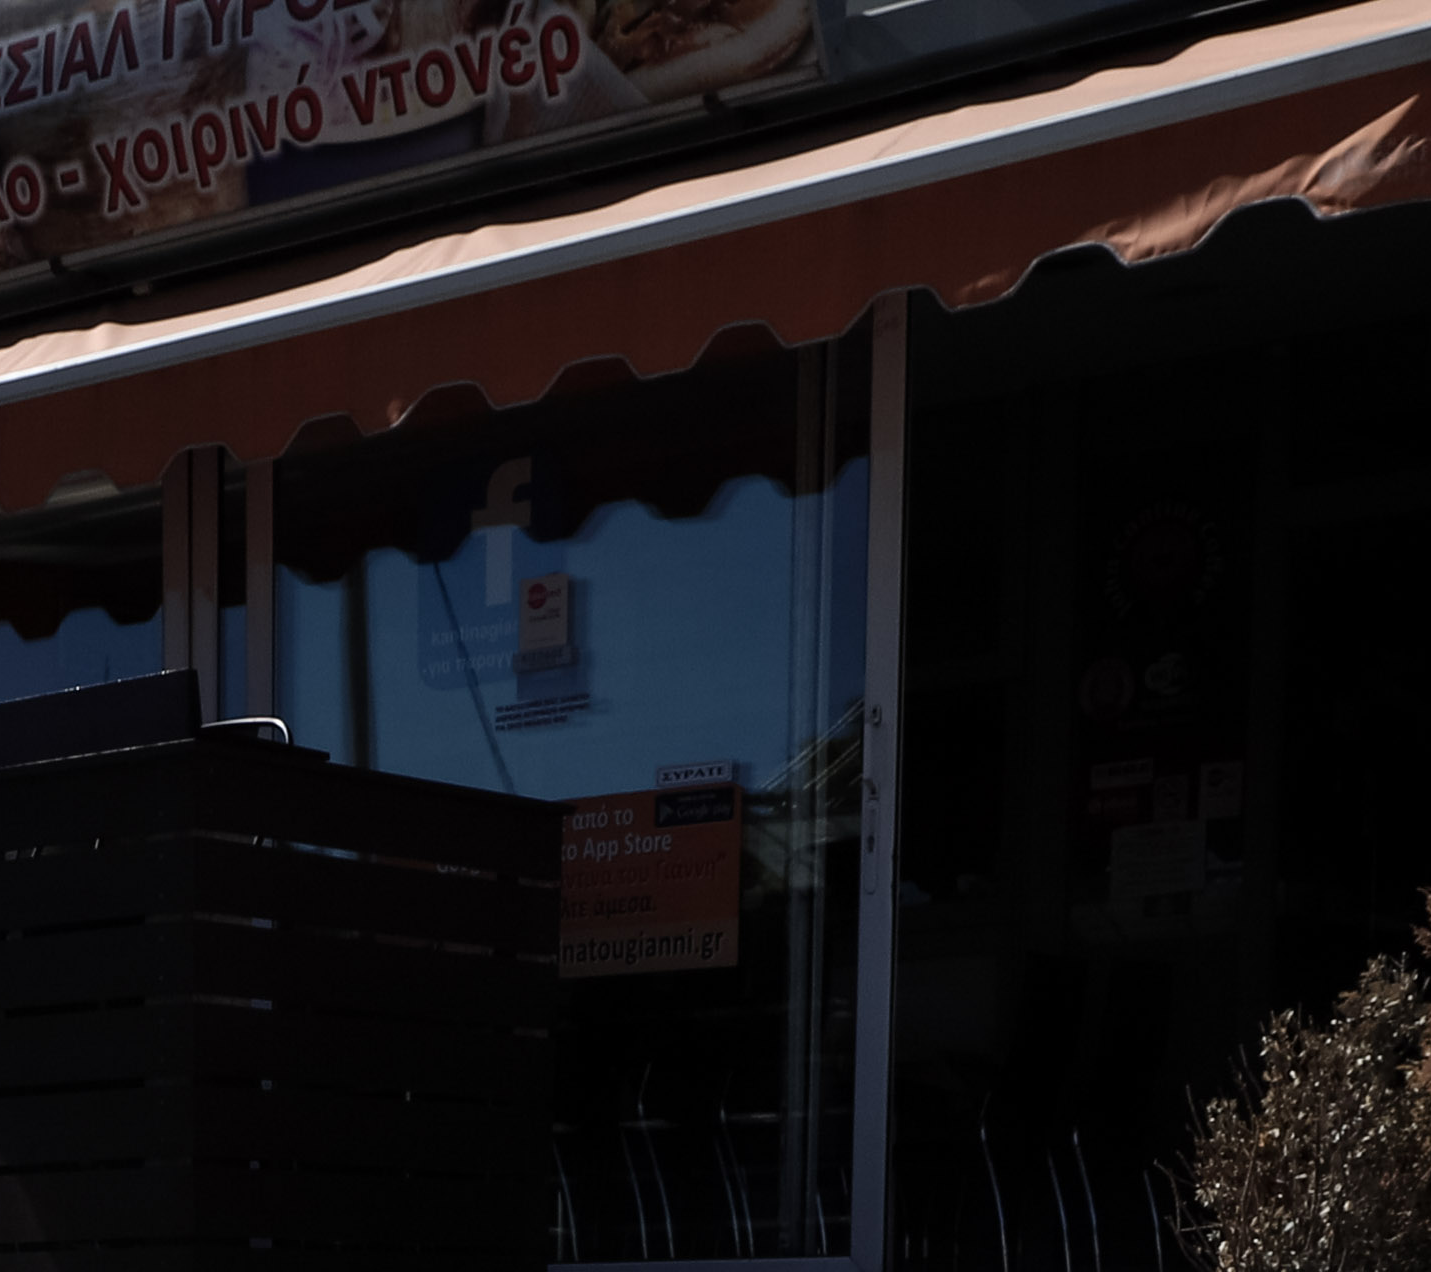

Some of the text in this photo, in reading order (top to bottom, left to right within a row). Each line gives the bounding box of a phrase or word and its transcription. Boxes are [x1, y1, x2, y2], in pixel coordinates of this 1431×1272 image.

[96, 65, 323, 213] χοιρινό
[342, 3, 581, 126] ντονέρ
[571, 803, 634, 833] από το
[583, 837, 619, 862] App
[624, 831, 673, 856] Store
[561, 927, 725, 966] natougianni.gr
